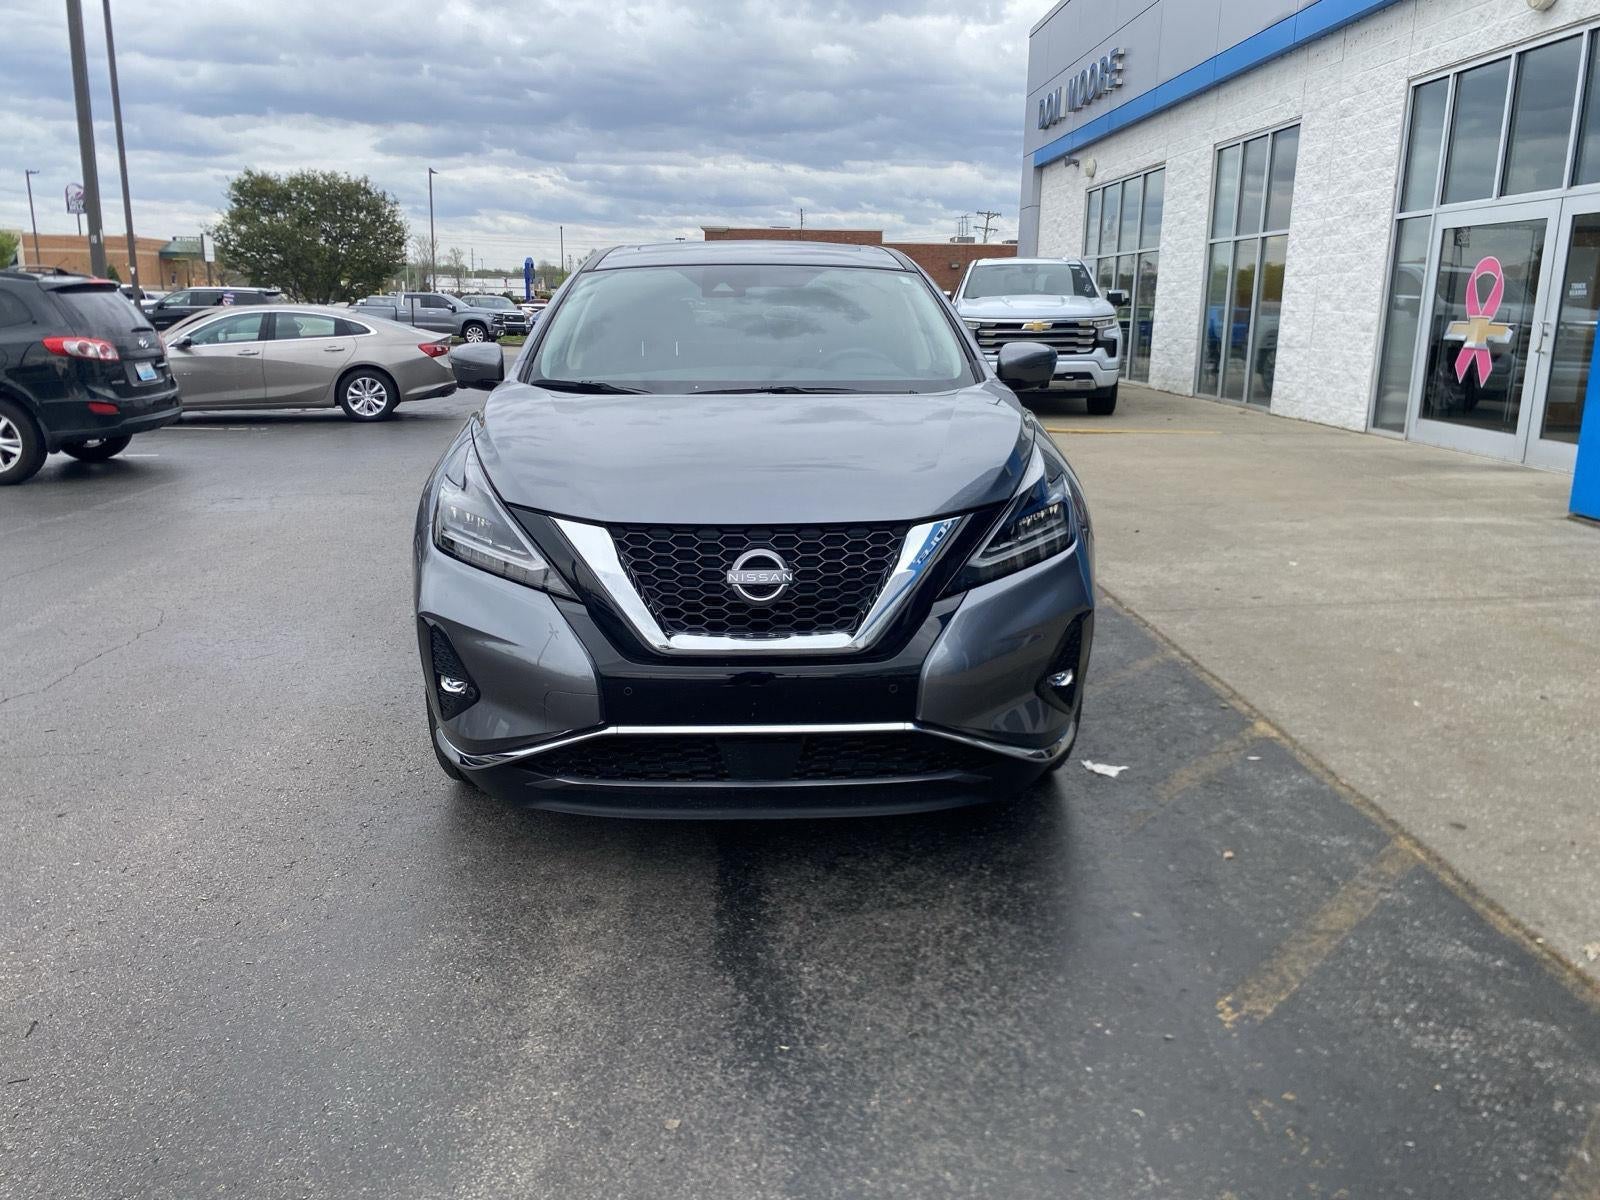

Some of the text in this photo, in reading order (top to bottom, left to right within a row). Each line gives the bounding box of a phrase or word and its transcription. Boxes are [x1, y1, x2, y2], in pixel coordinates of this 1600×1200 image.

[1038, 48, 1124, 129] DON MOORE
[728, 572, 793, 582] NISSAN
